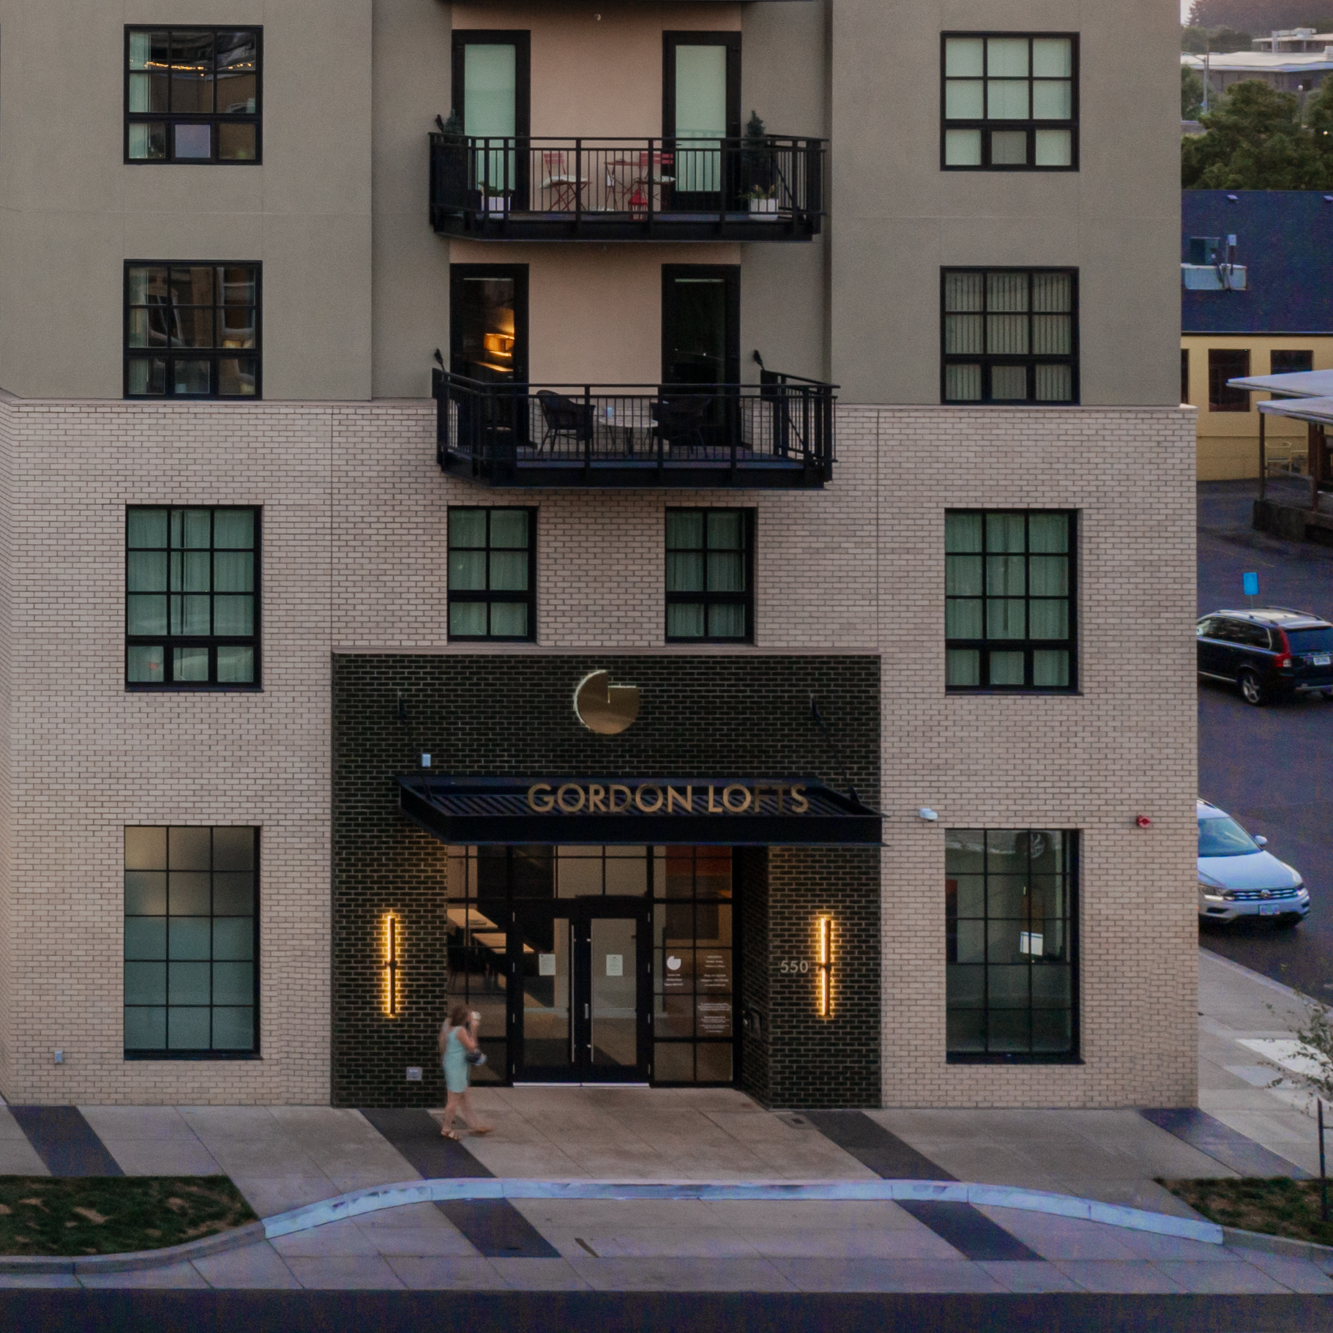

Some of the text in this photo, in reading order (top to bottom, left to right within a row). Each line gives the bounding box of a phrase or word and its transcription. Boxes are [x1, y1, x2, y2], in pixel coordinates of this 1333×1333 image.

[527, 783, 809, 813] GORDON LOFTS
[780, 960, 809, 973] 550
